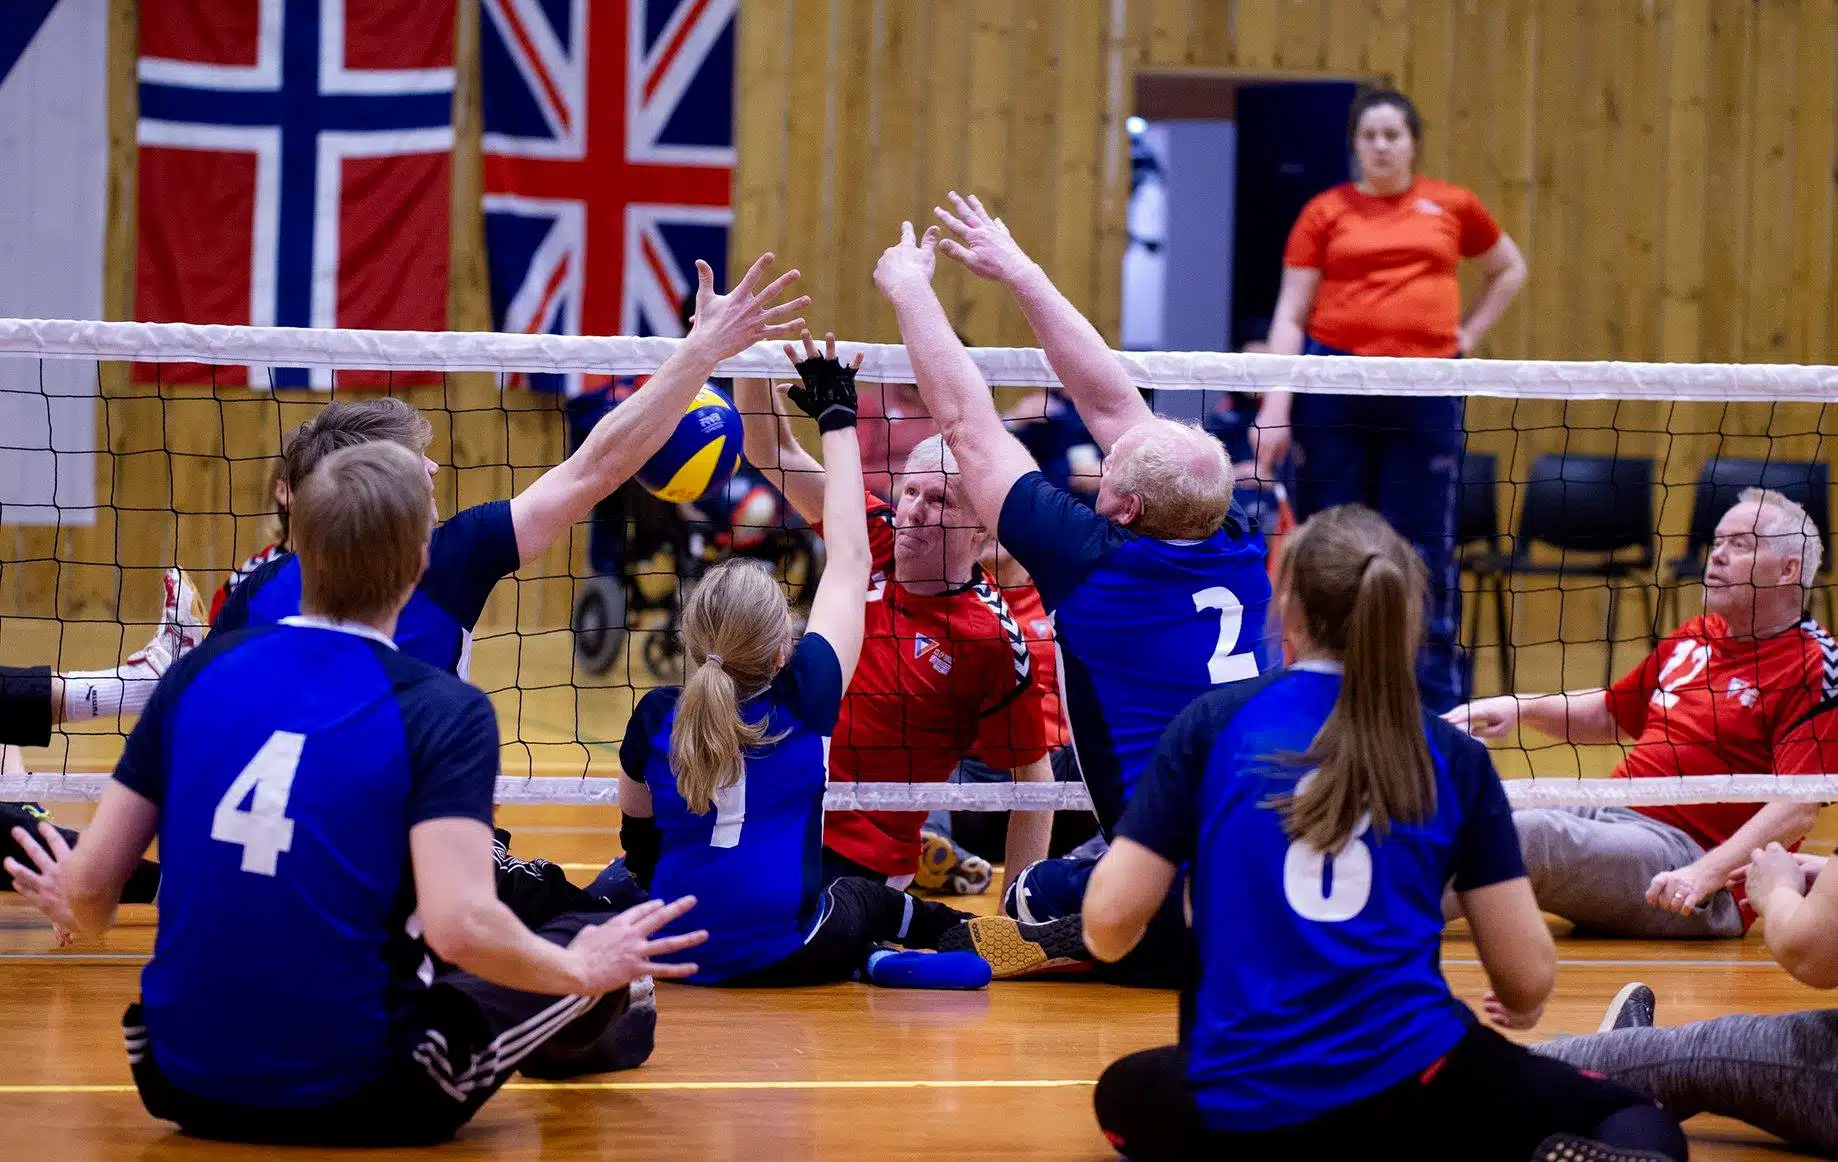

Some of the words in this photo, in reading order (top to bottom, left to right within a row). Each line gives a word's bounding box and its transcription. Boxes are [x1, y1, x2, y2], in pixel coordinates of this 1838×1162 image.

[1192, 586, 1260, 684] 2
[1651, 639, 1712, 709] 12
[210, 730, 307, 877] 4
